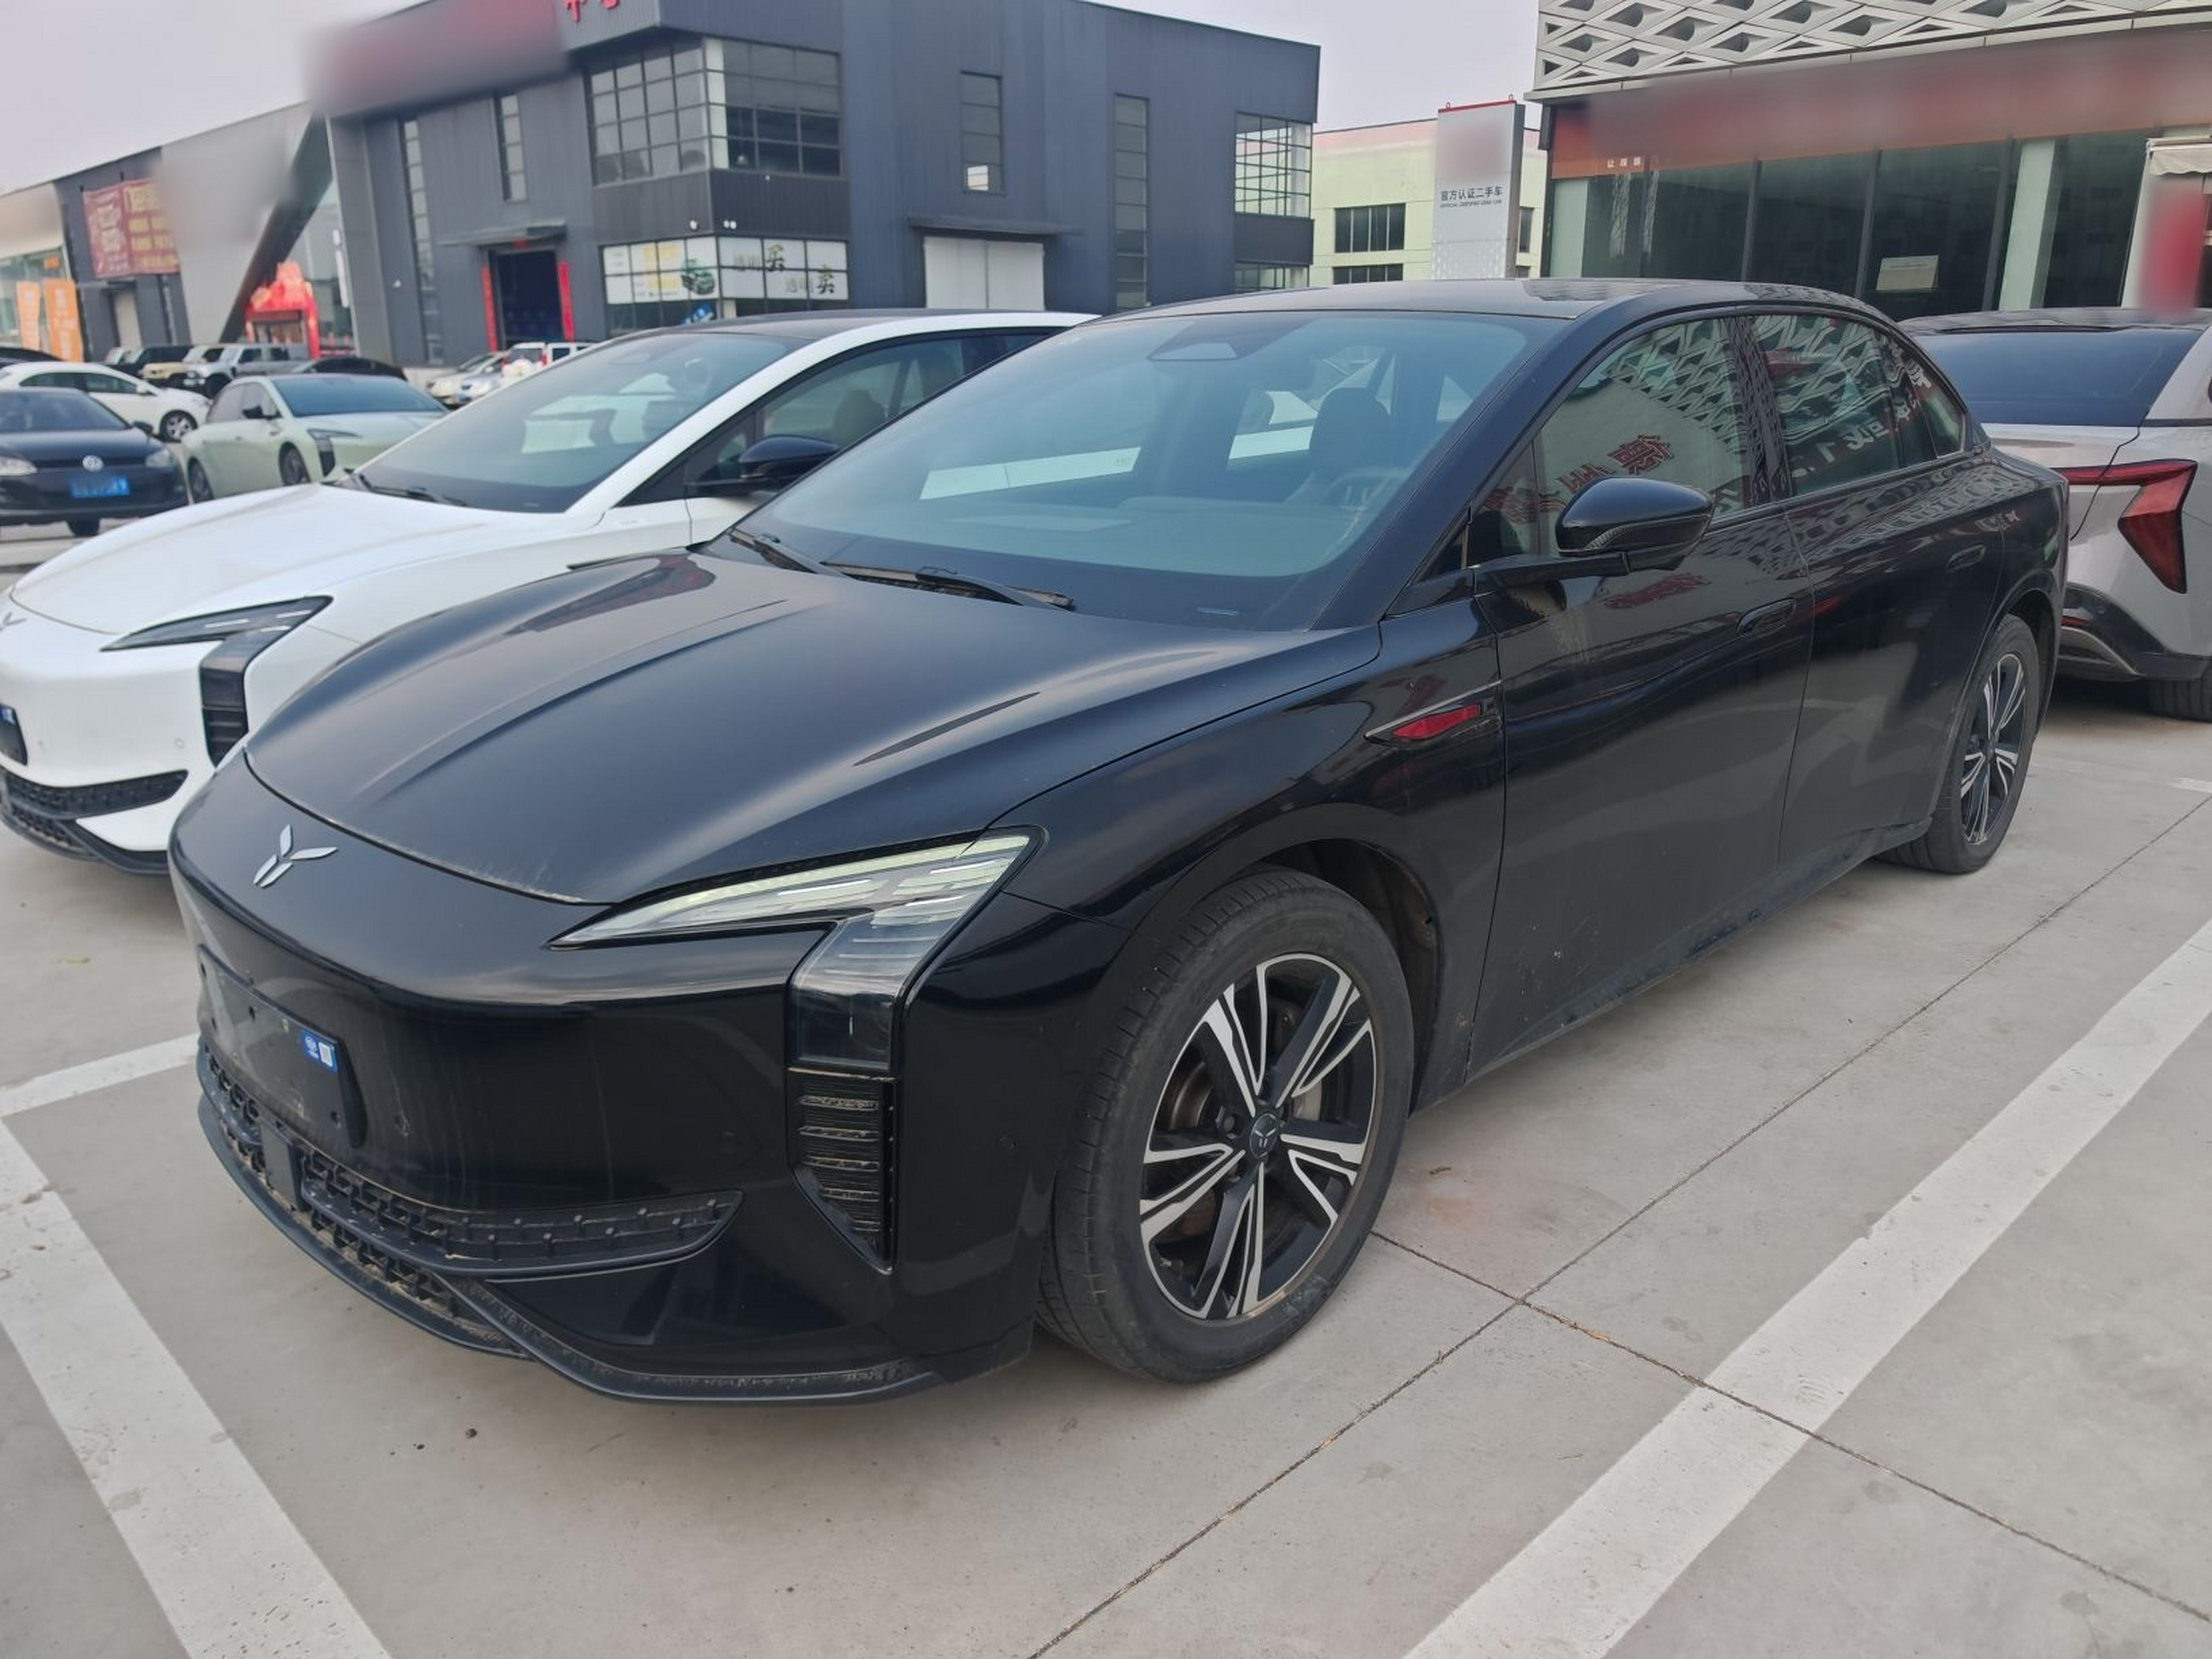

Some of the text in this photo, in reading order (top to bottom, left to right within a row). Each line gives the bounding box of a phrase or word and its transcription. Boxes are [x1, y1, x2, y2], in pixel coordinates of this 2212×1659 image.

[1441, 186, 1503, 201] 官方认证二手车
